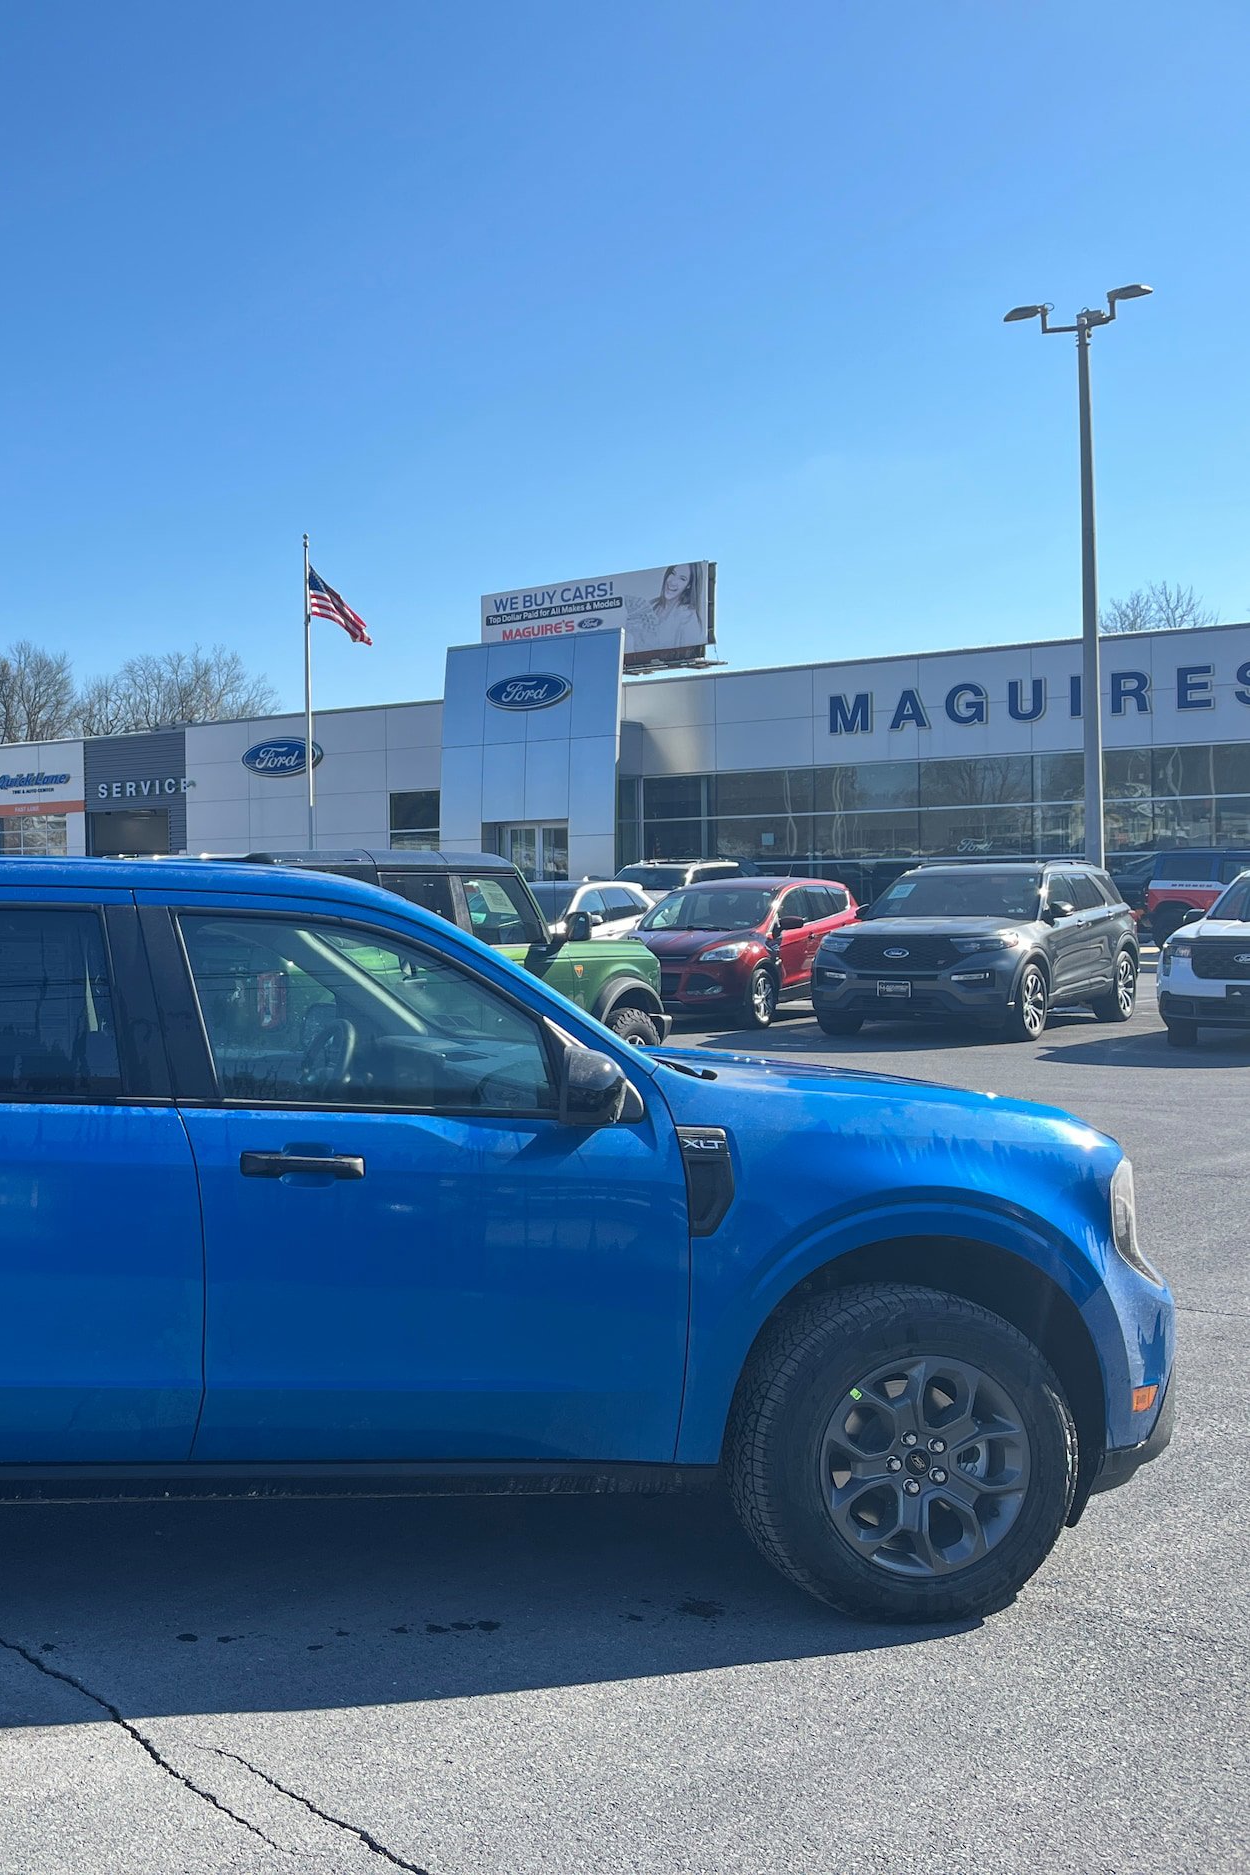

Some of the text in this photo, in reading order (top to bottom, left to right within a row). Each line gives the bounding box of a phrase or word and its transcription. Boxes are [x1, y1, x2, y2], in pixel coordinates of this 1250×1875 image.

[494, 581, 614, 612] WE BUY CARS!
[489, 599, 621, 624] Top Dollar Paid for All Makes & Models
[502, 619, 575, 640] MAGUIRE'S
[501, 681, 548, 702] Ford
[255, 747, 299, 769] Ford
[35, 773, 69, 785] Lane
[98, 778, 190, 799] SERVICE
[957, 837, 993, 851] Ford
[682, 1138, 725, 1149] XLT
